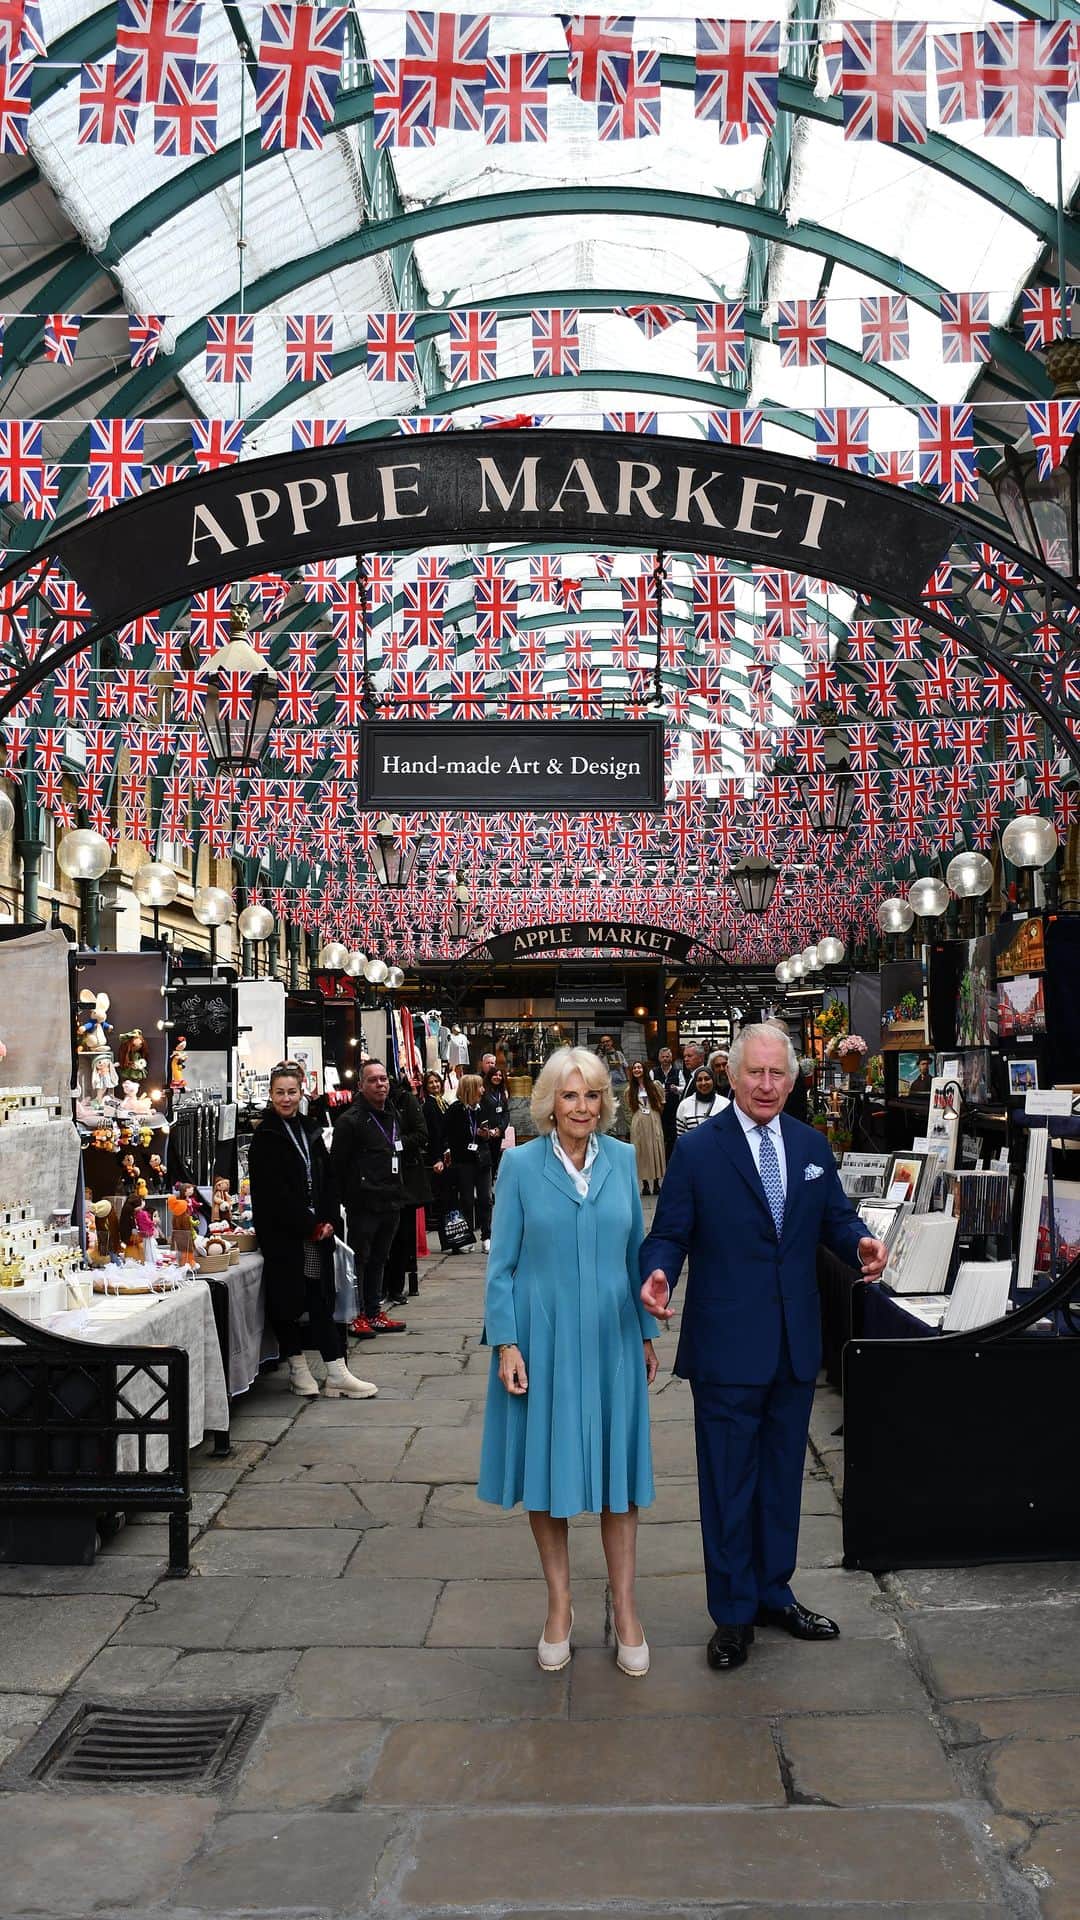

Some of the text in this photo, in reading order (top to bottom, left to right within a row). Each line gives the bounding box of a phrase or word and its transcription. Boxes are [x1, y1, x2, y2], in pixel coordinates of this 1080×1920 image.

[187, 456, 846, 566] APPLE MARKET
[381, 755, 641, 779] Hand-made Art & Design
[513, 927, 676, 951] APPLE MARKET
[604, 996, 621, 1004] Design
